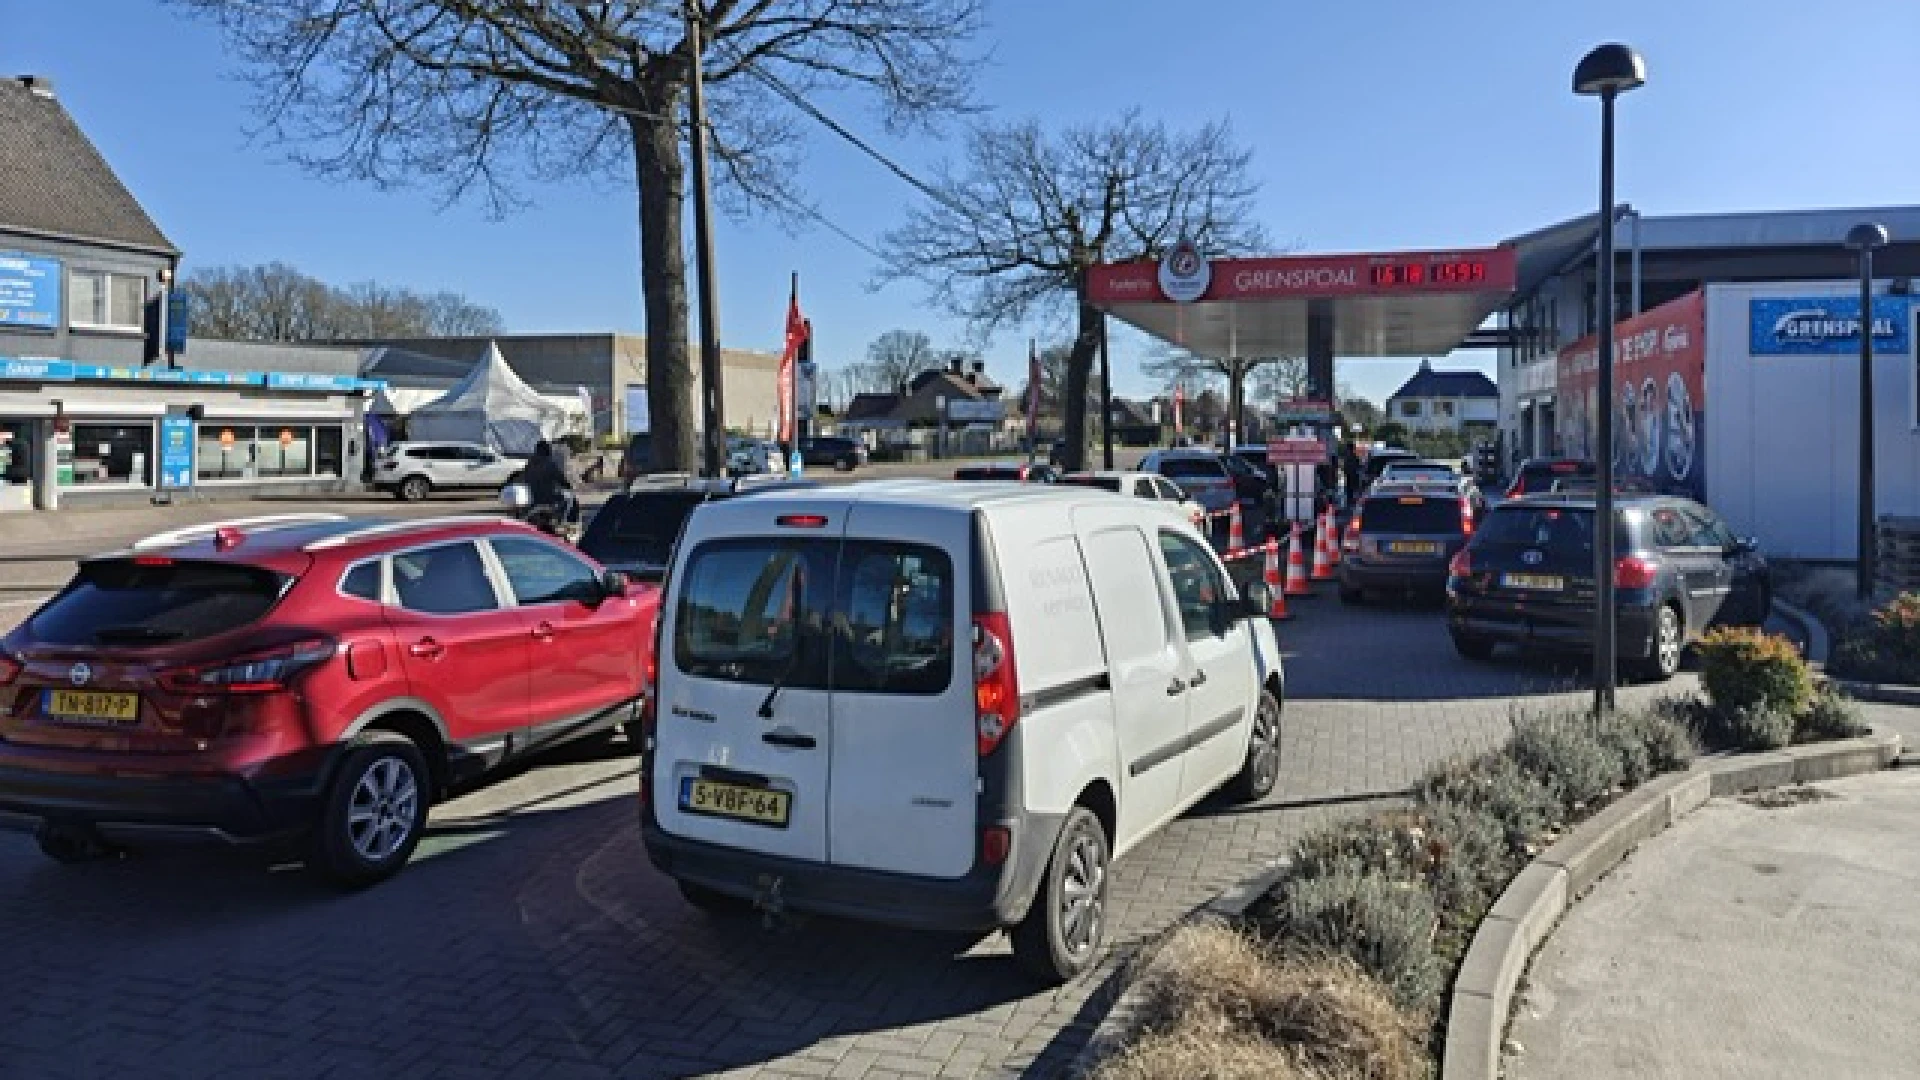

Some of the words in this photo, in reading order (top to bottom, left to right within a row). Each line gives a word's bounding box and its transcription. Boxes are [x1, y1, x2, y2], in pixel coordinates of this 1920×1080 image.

[1234, 267, 1358, 291] GRENSPOAL
[1786, 317, 1894, 337] GRENSPAL
[694, 784, 779, 817] 5-VBF-64
